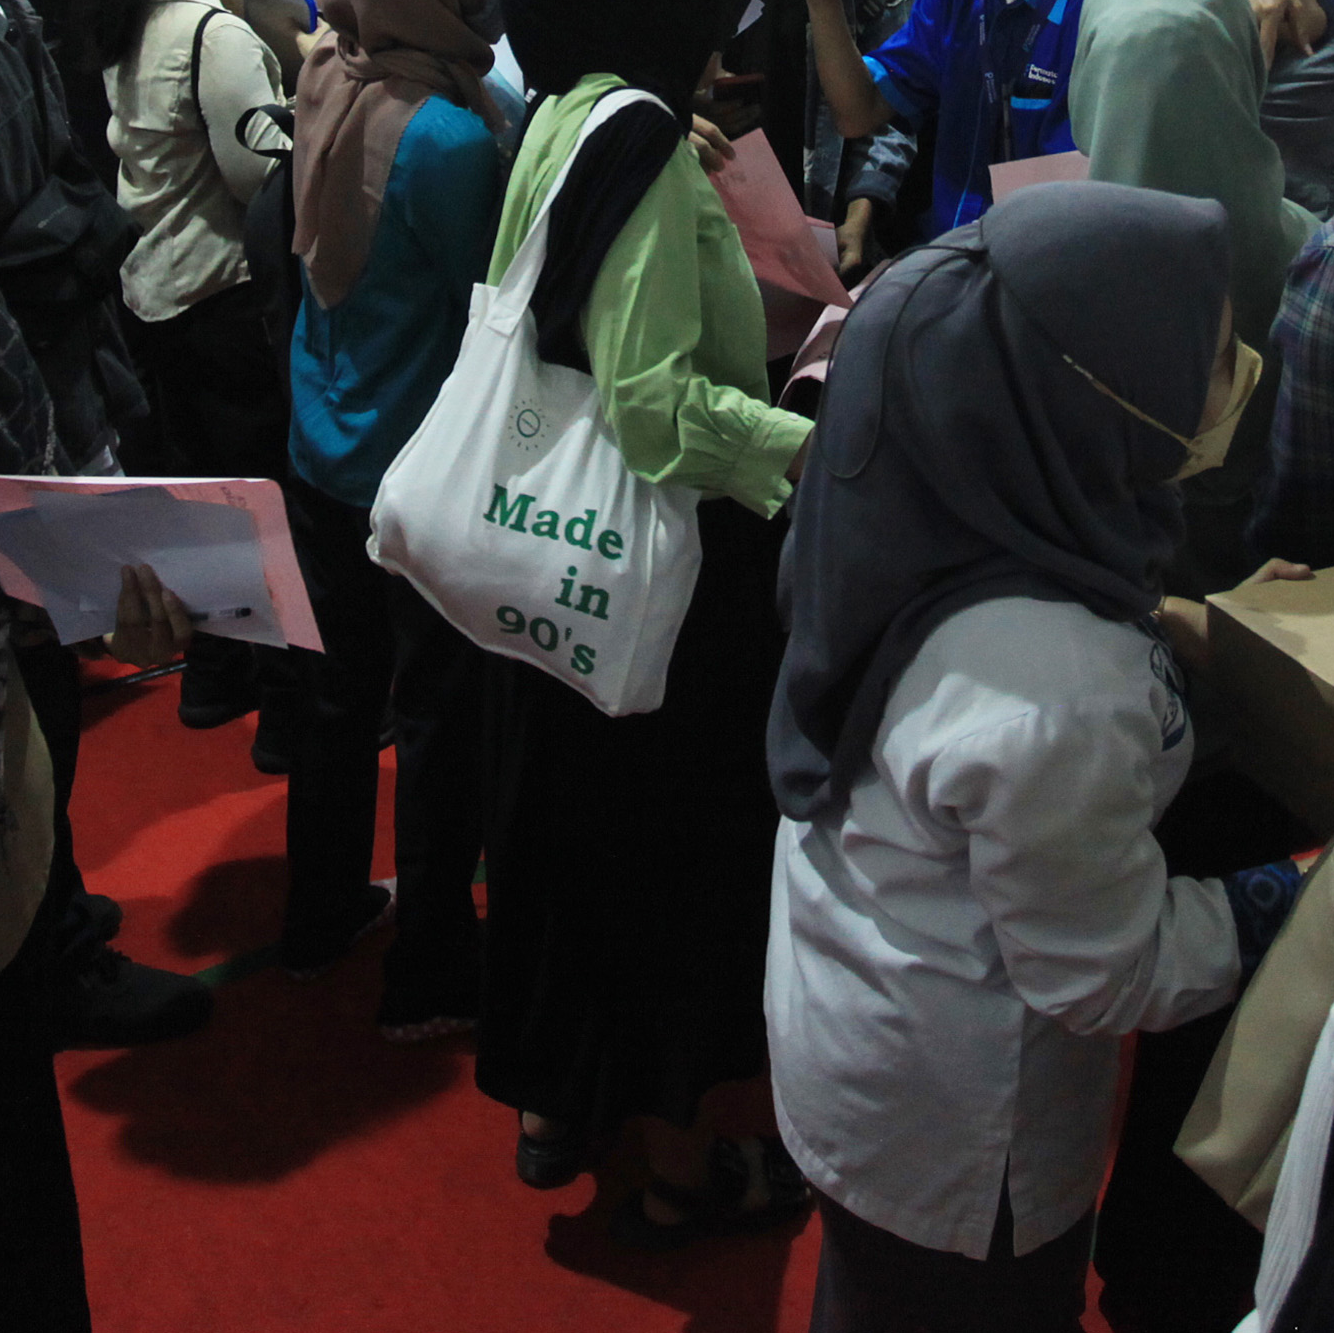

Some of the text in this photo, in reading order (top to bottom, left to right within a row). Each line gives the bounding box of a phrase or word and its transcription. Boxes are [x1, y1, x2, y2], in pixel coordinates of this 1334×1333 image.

[483, 484, 625, 560] Made
[555, 565, 610, 620] in
[496, 605, 597, 676] 90's
